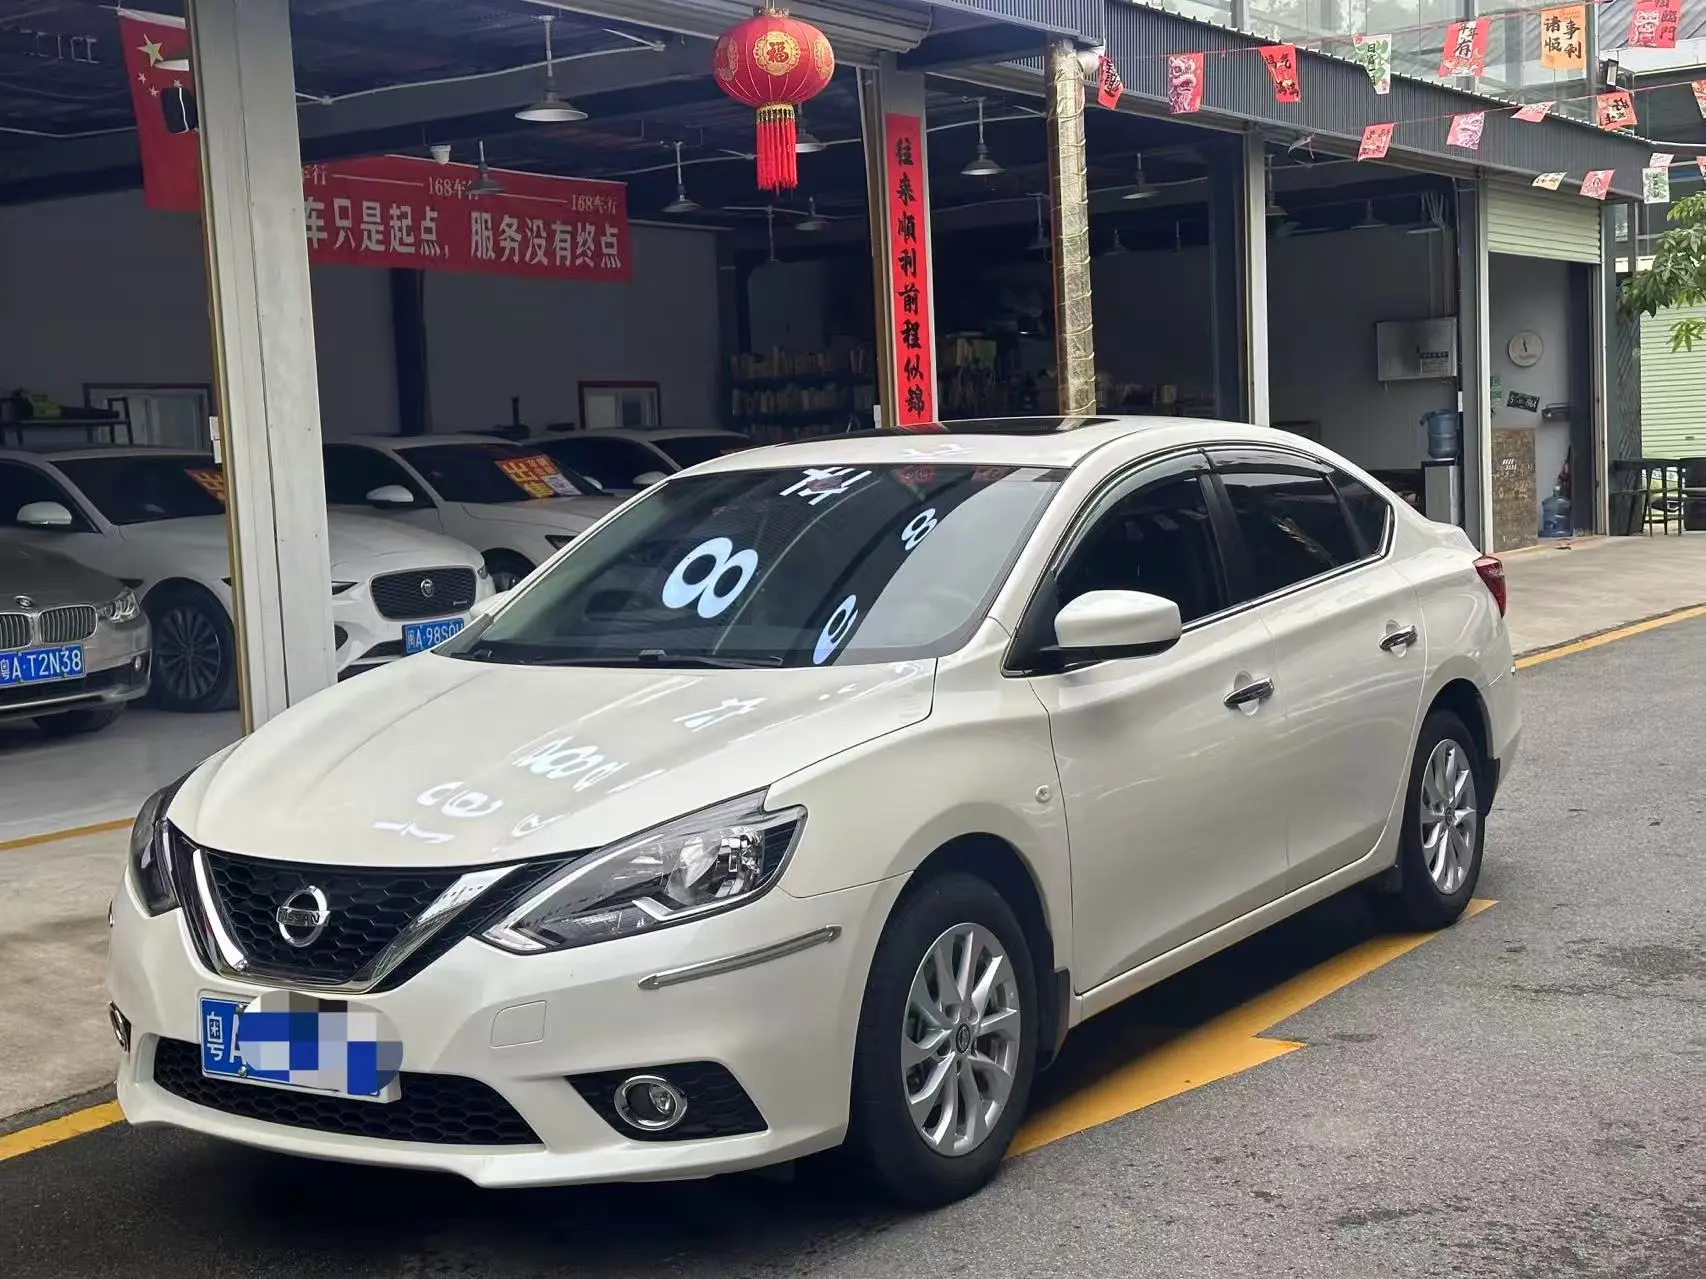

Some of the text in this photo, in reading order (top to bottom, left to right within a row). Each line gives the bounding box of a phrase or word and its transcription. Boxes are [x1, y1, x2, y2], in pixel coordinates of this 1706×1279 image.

[766, 41, 789, 62] 福
[470, 211, 622, 269] 服务没有终点
[280, 909, 321, 926] NISSAN
